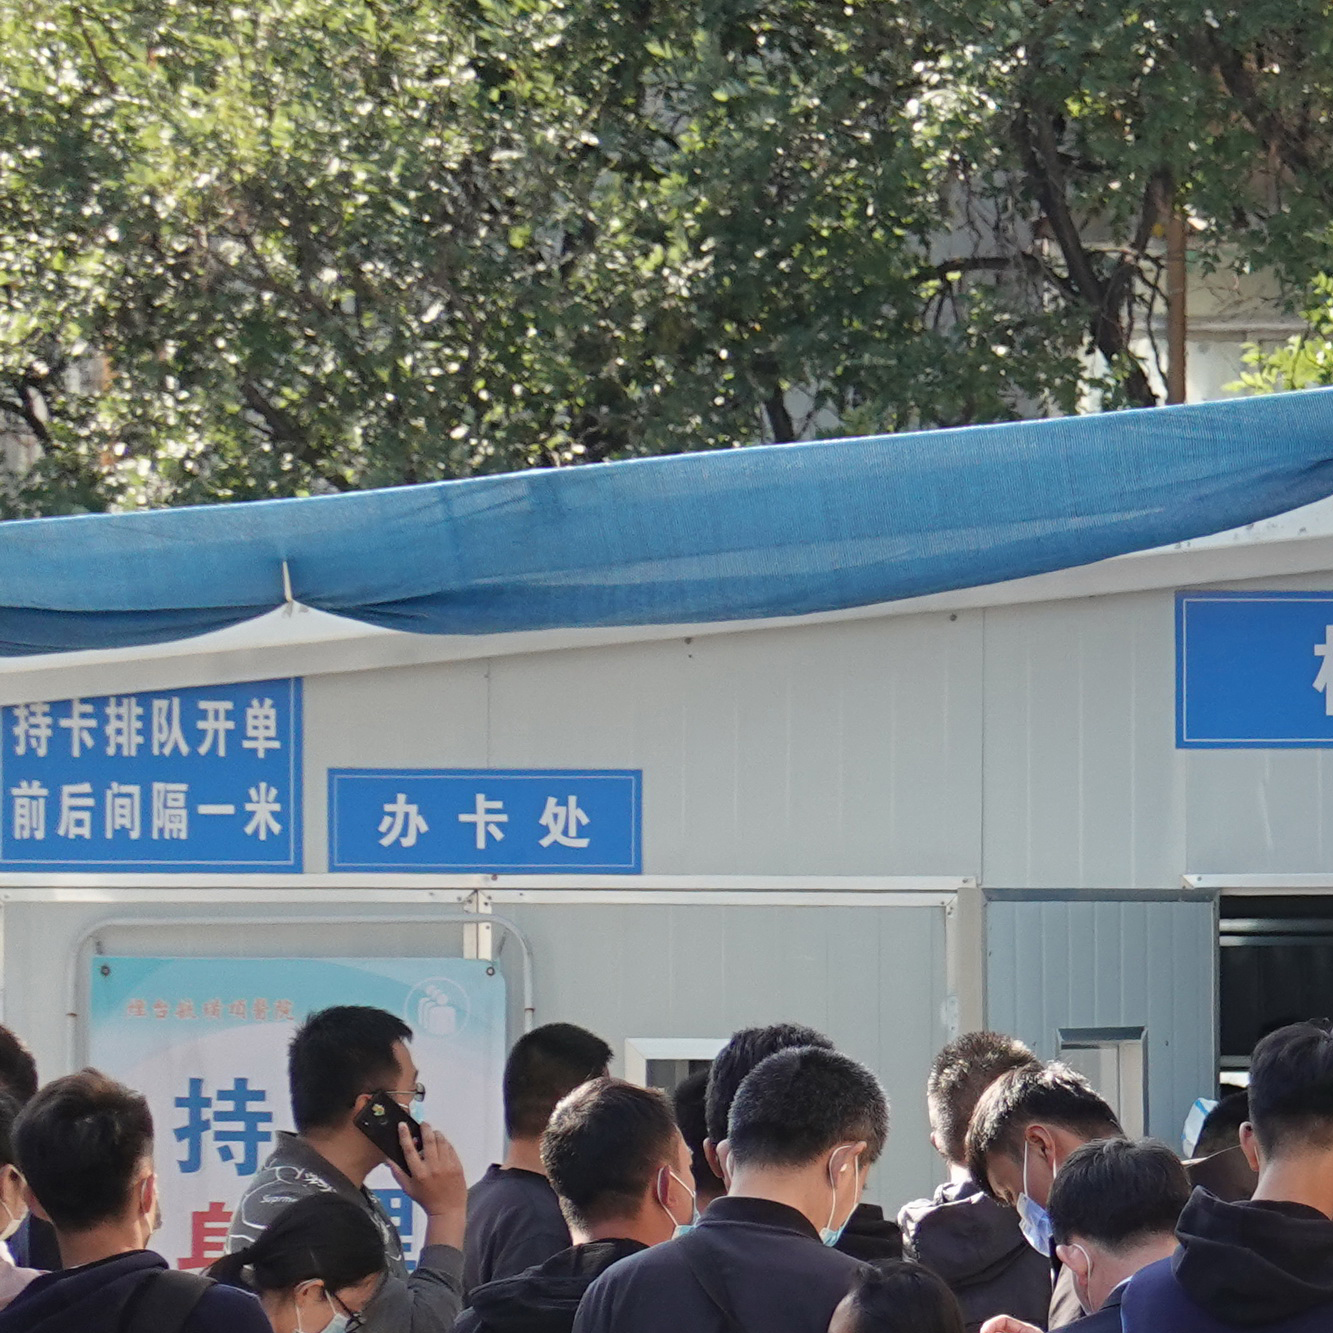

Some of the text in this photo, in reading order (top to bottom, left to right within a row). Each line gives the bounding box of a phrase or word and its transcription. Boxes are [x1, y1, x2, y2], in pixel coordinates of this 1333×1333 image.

[11, 697, 281, 758] 持卡排队开单
[10, 779, 283, 840] 前后间隔一米
[377, 794, 592, 849] 办卡处
[173, 1077, 273, 1177] 持
